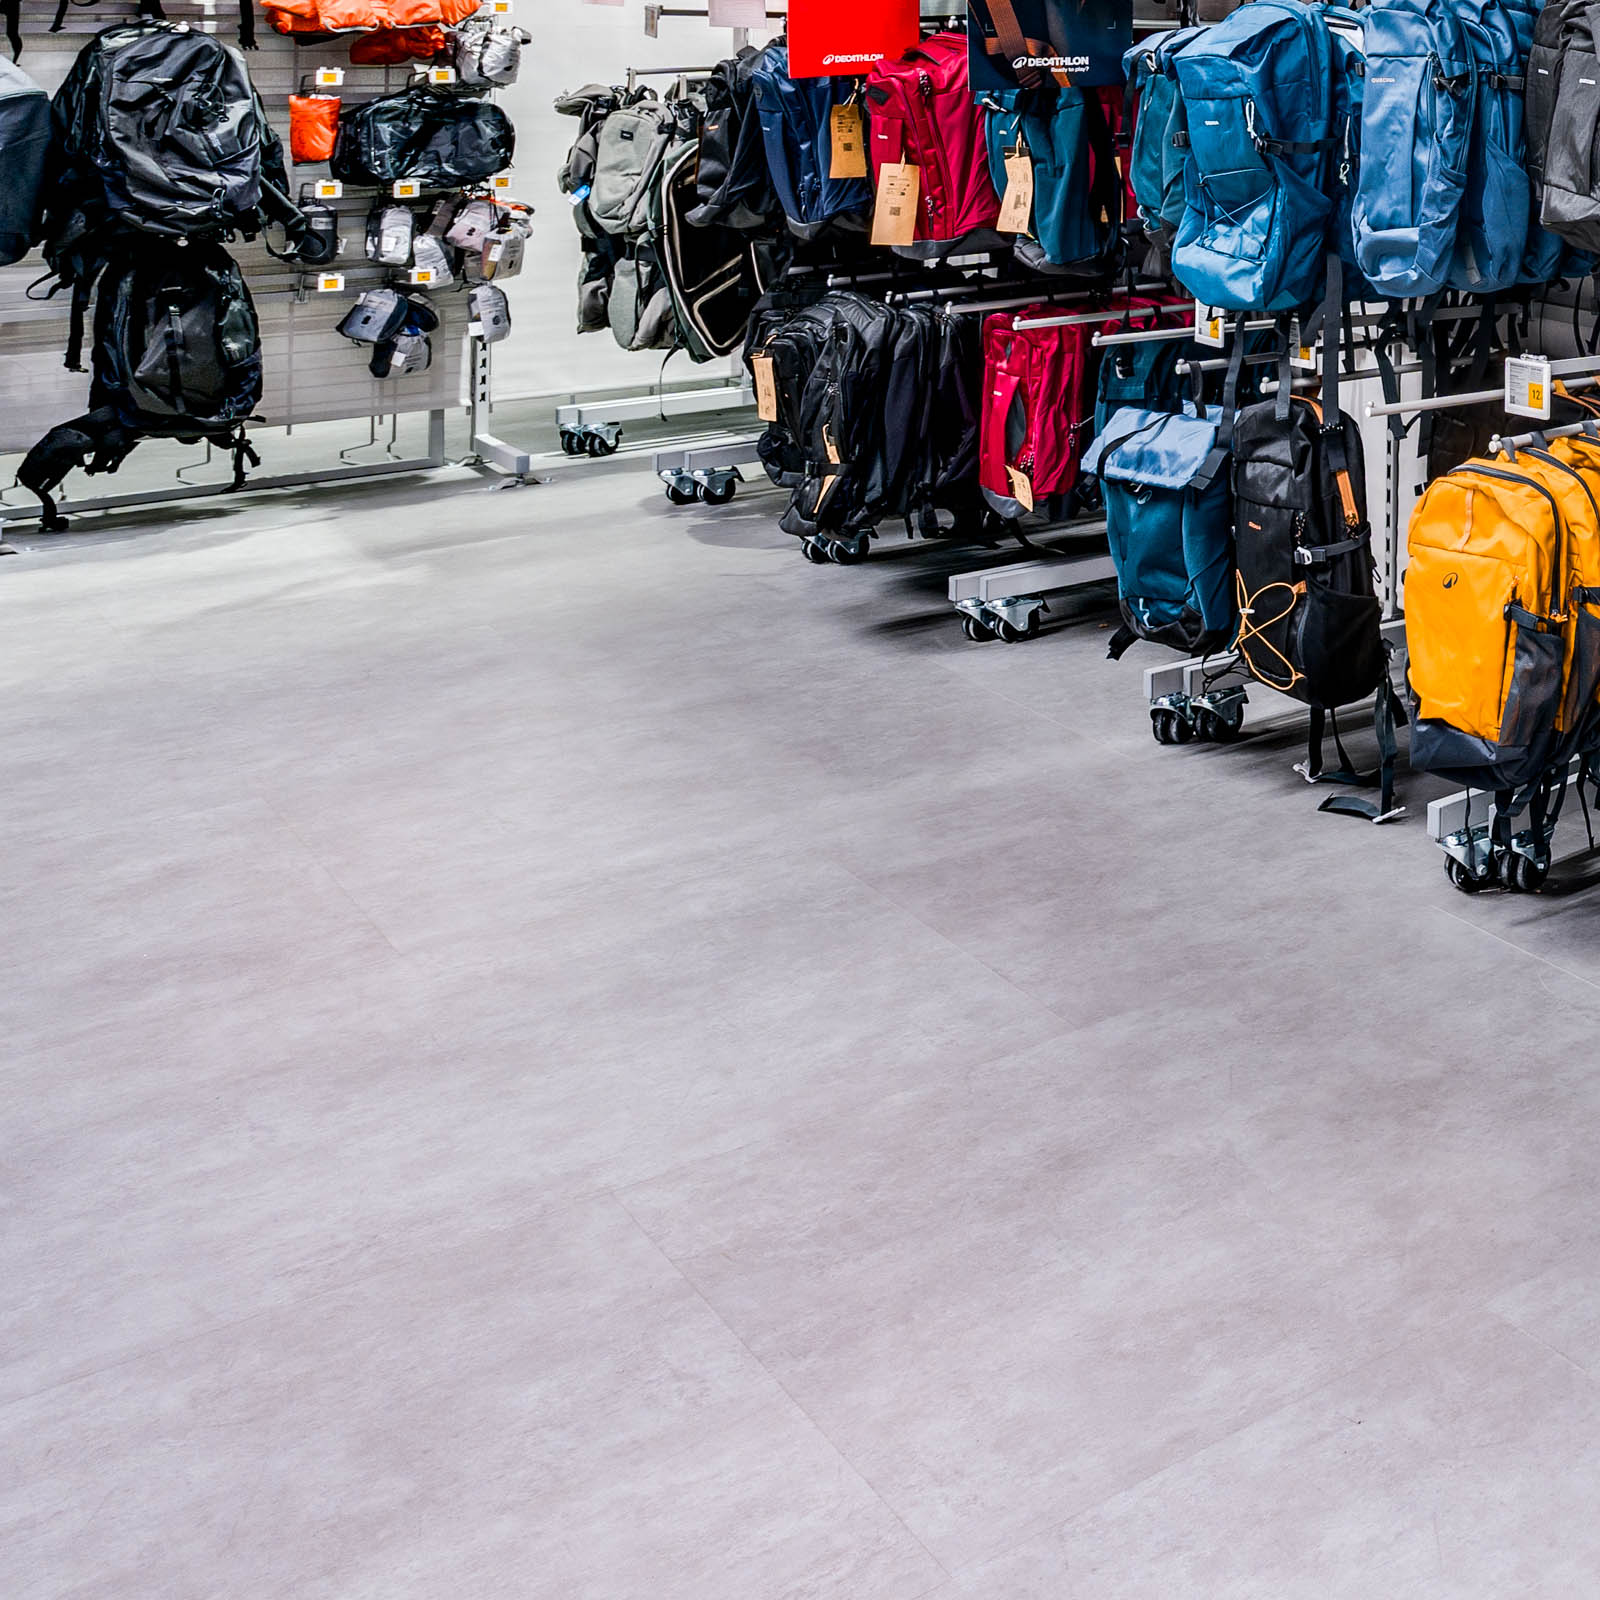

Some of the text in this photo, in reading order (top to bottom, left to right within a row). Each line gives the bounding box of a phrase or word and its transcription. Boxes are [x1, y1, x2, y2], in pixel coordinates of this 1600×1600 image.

[834, 53, 884, 64] DECATHLON
[1028, 56, 1089, 67] DECATHLON
[1532, 389, 1540, 400] 12
